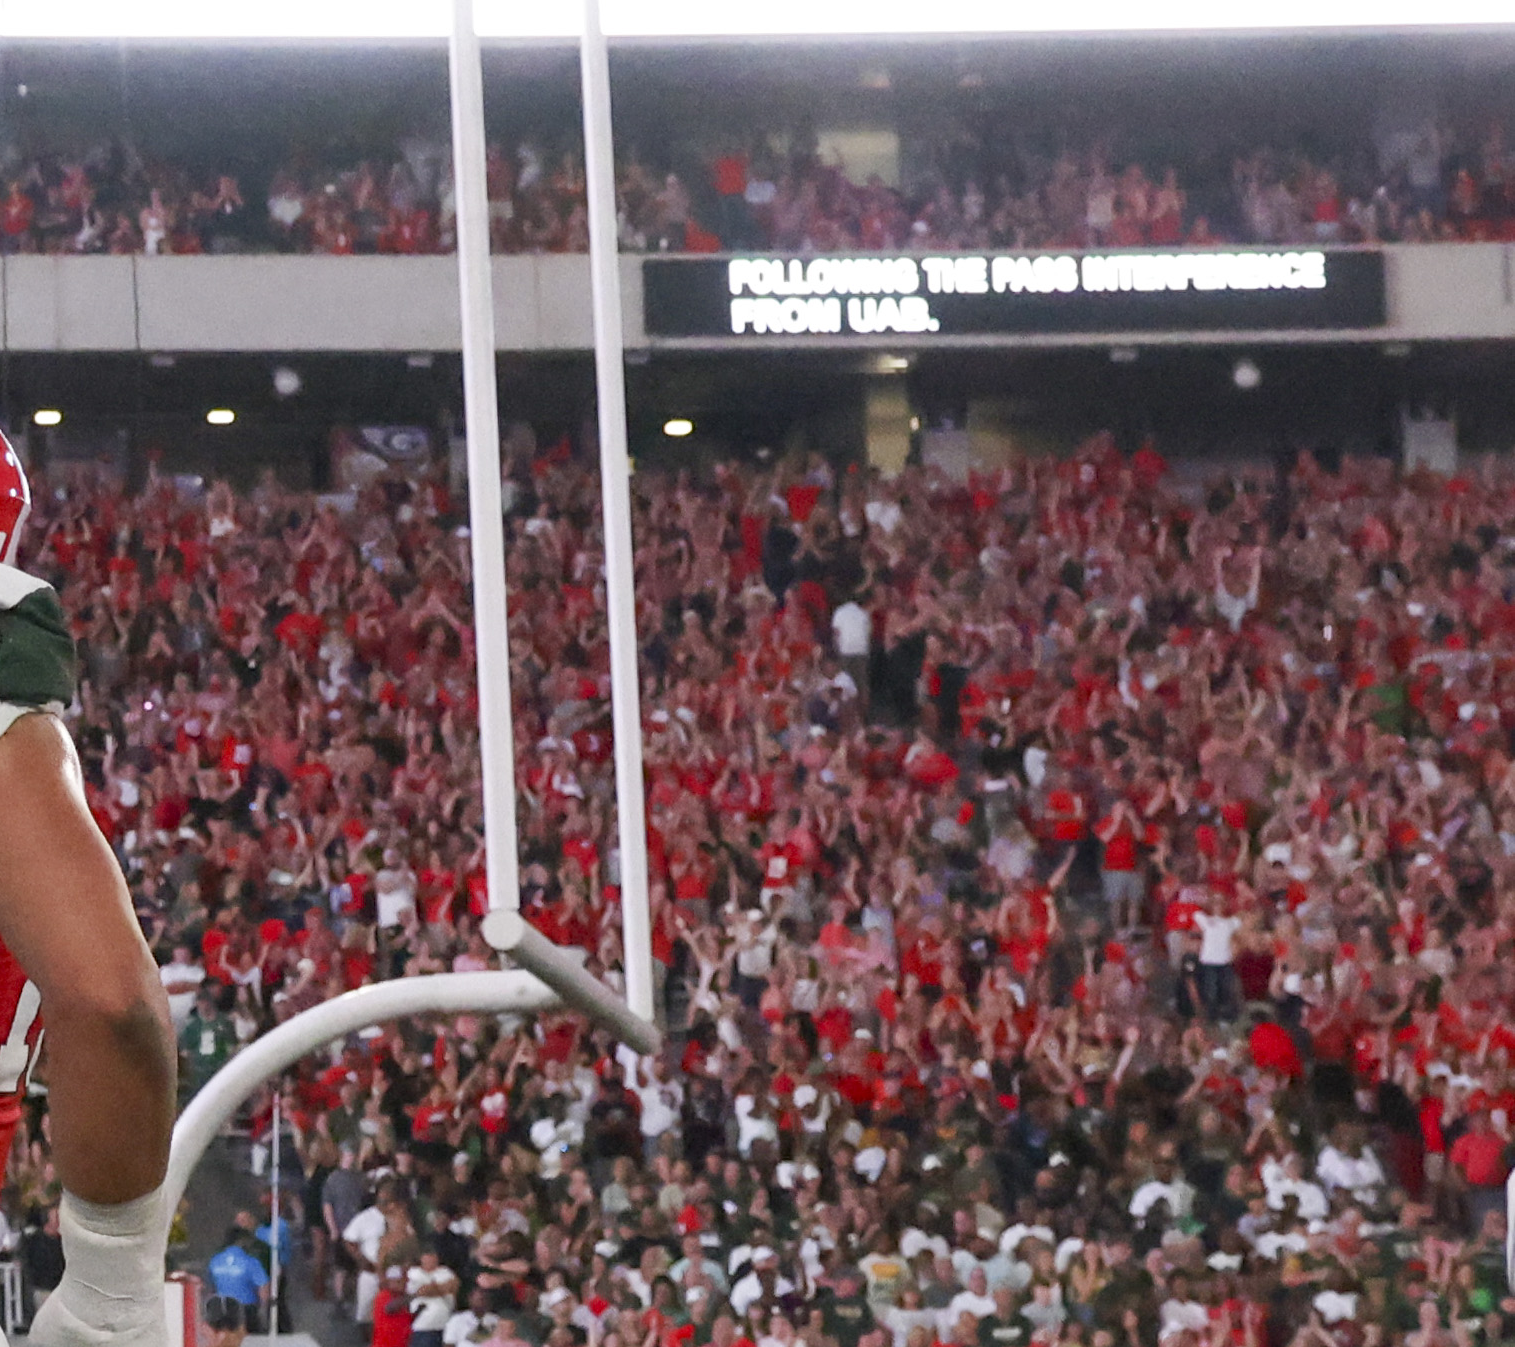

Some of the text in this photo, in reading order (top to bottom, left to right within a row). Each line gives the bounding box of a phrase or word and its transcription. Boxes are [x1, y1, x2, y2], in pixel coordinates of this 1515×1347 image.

[728, 250, 1326, 296] FOLLOWING THE PASS INTERFERENCE
[730, 295, 941, 334] FROM UAB.
